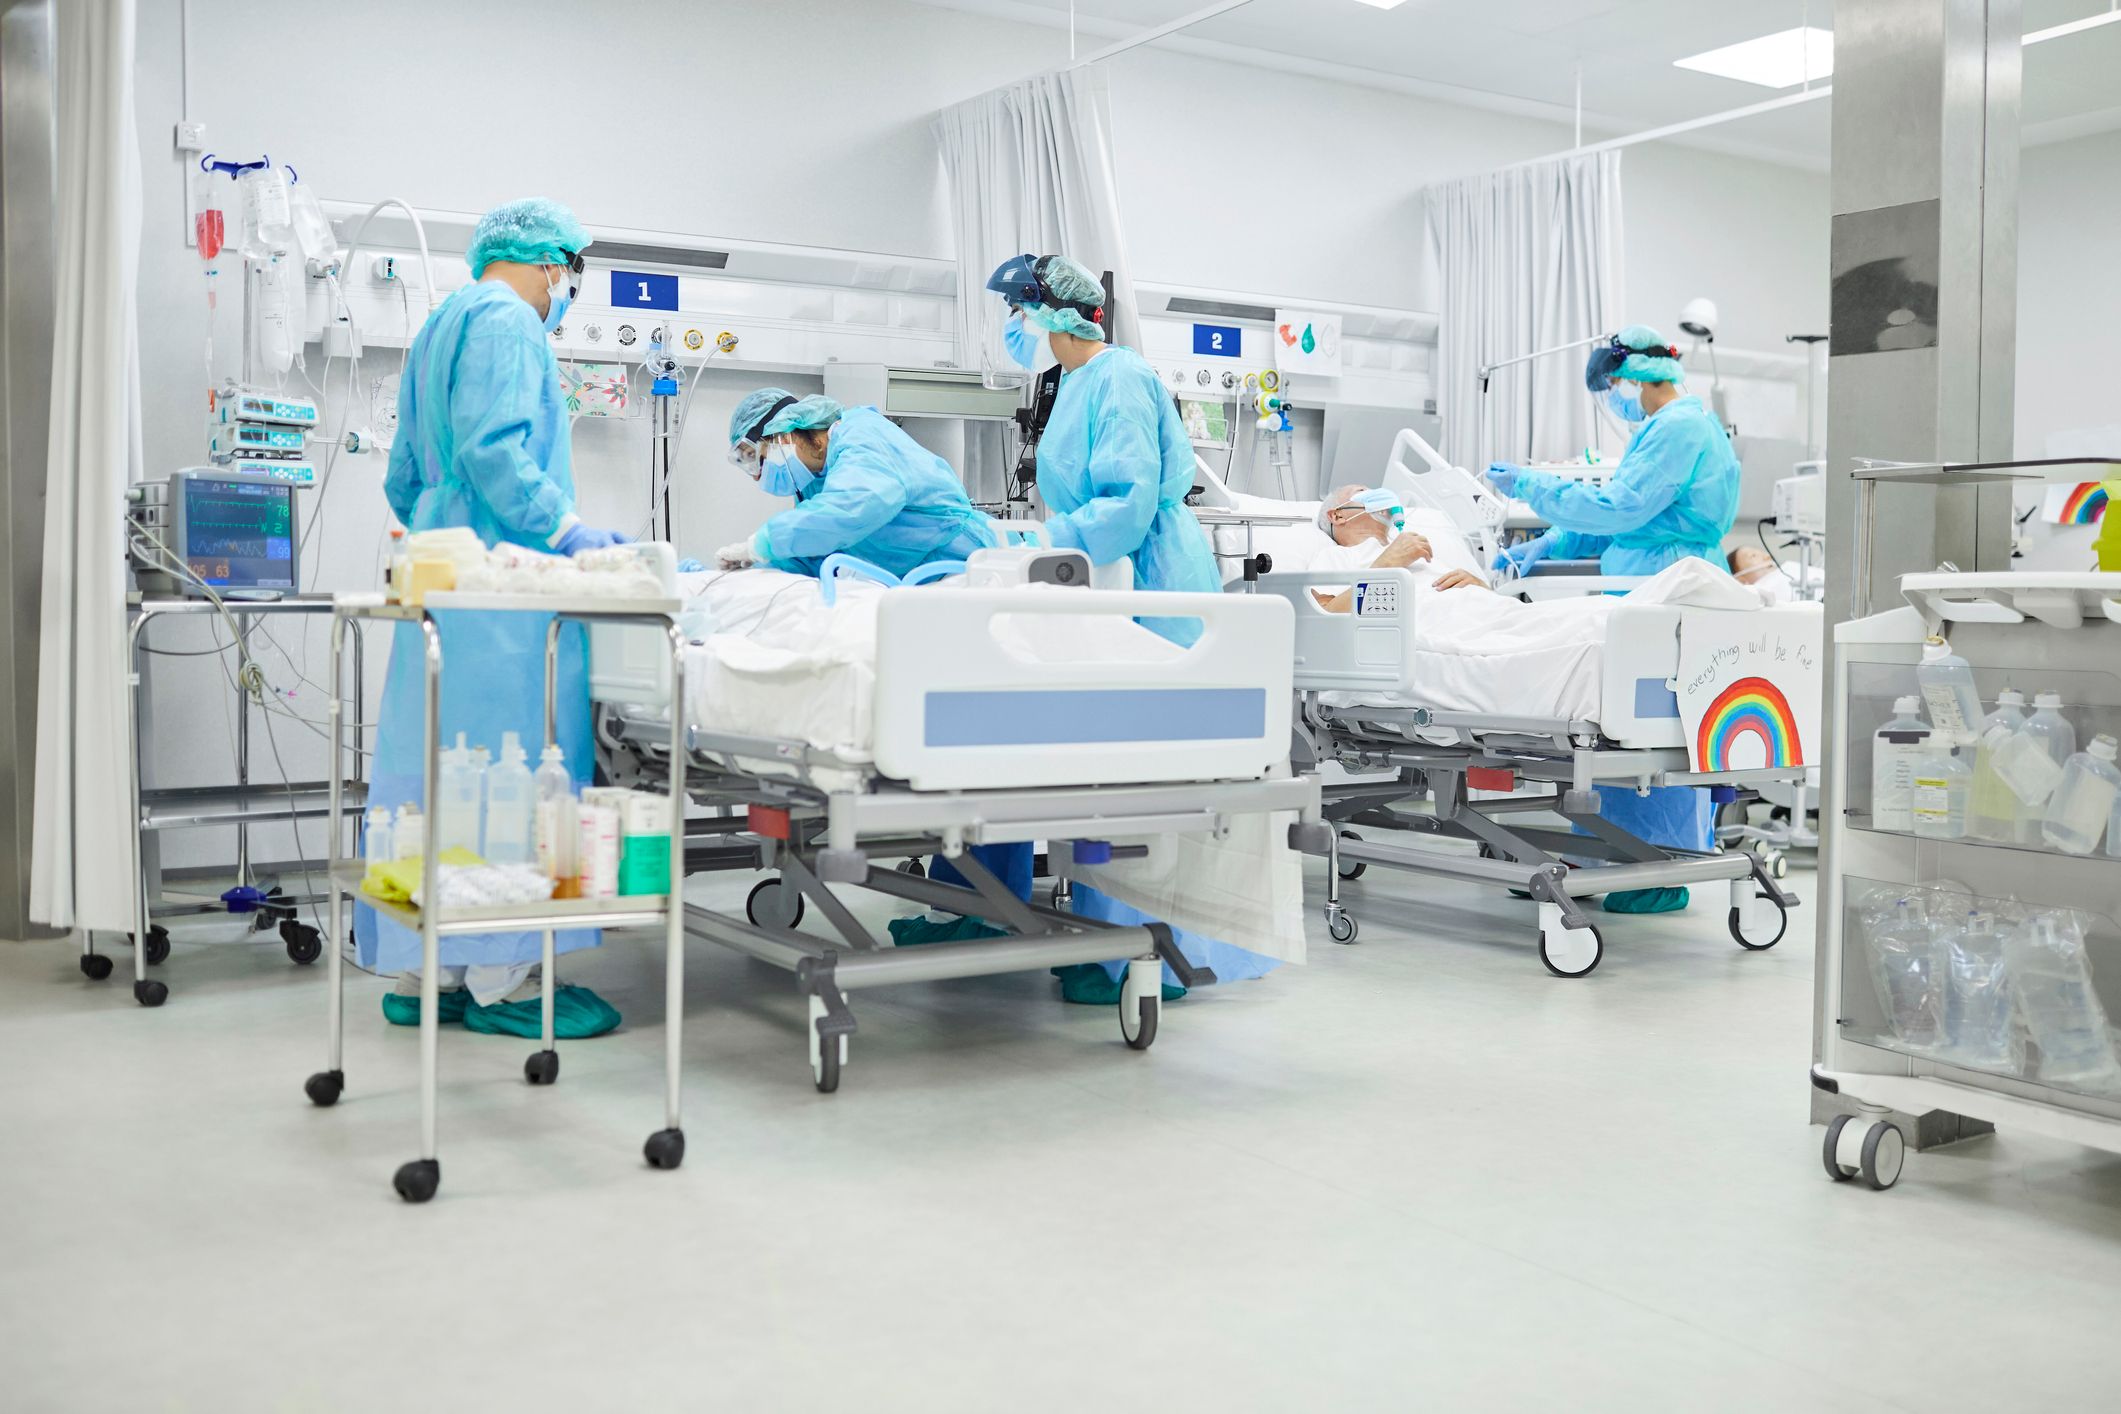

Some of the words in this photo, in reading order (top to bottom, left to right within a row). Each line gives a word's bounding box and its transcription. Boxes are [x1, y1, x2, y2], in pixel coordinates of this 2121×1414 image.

[638, 282, 652, 302] 1
[1212, 332, 1223, 350] 2
[277, 504, 289, 517] 78
[278, 547, 290, 559] 99
[215, 565, 229, 577] 63
[1687, 645, 1740, 695] everything
[1749, 632, 1767, 654] will
[1775, 635, 1787, 662] be
[1796, 644, 1812, 670] fine
